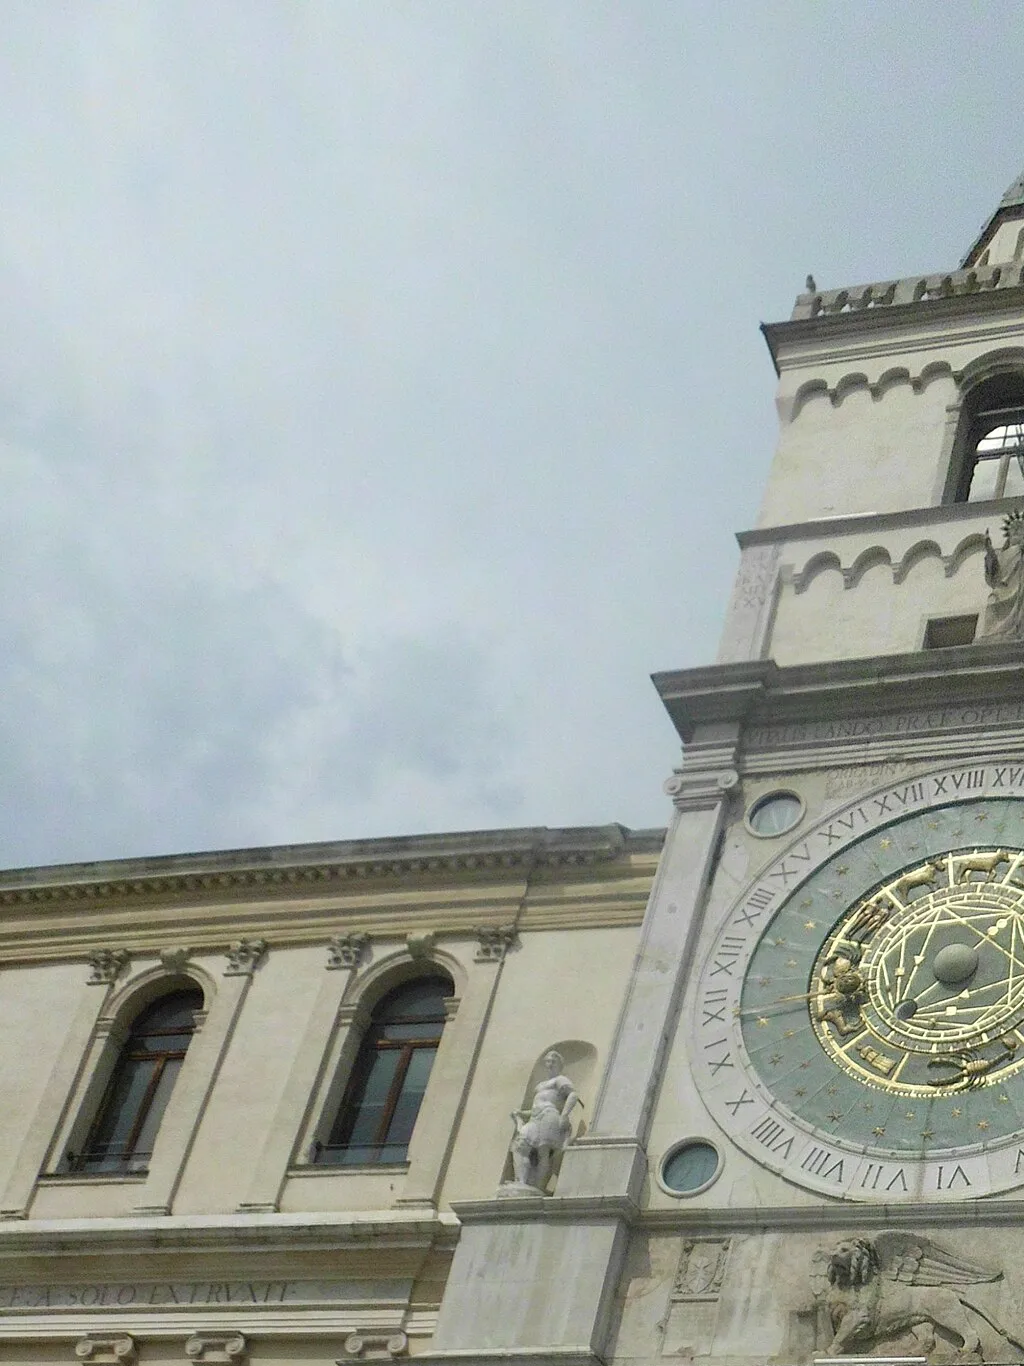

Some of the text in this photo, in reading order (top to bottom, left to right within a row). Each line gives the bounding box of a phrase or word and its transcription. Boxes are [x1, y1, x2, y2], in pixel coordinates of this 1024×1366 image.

[873, 782, 925, 816] XVII
[933, 769, 985, 796] XVIII
[818, 808, 869, 845] XVI
[770, 843, 811, 883] XV
[733, 888, 775, 928] XIIII
[709, 936, 746, 977] XIII
[702, 988, 728, 1026] XII
[704, 1038, 734, 1076] XI
[726, 1089, 754, 1116] X
[751, 1117, 797, 1160] VIIII
[801, 1147, 844, 1183] VIII
[861, 1164, 908, 1191] VII
[936, 1165, 972, 1189] VI
[68, 1285, 136, 1306] SOLO
